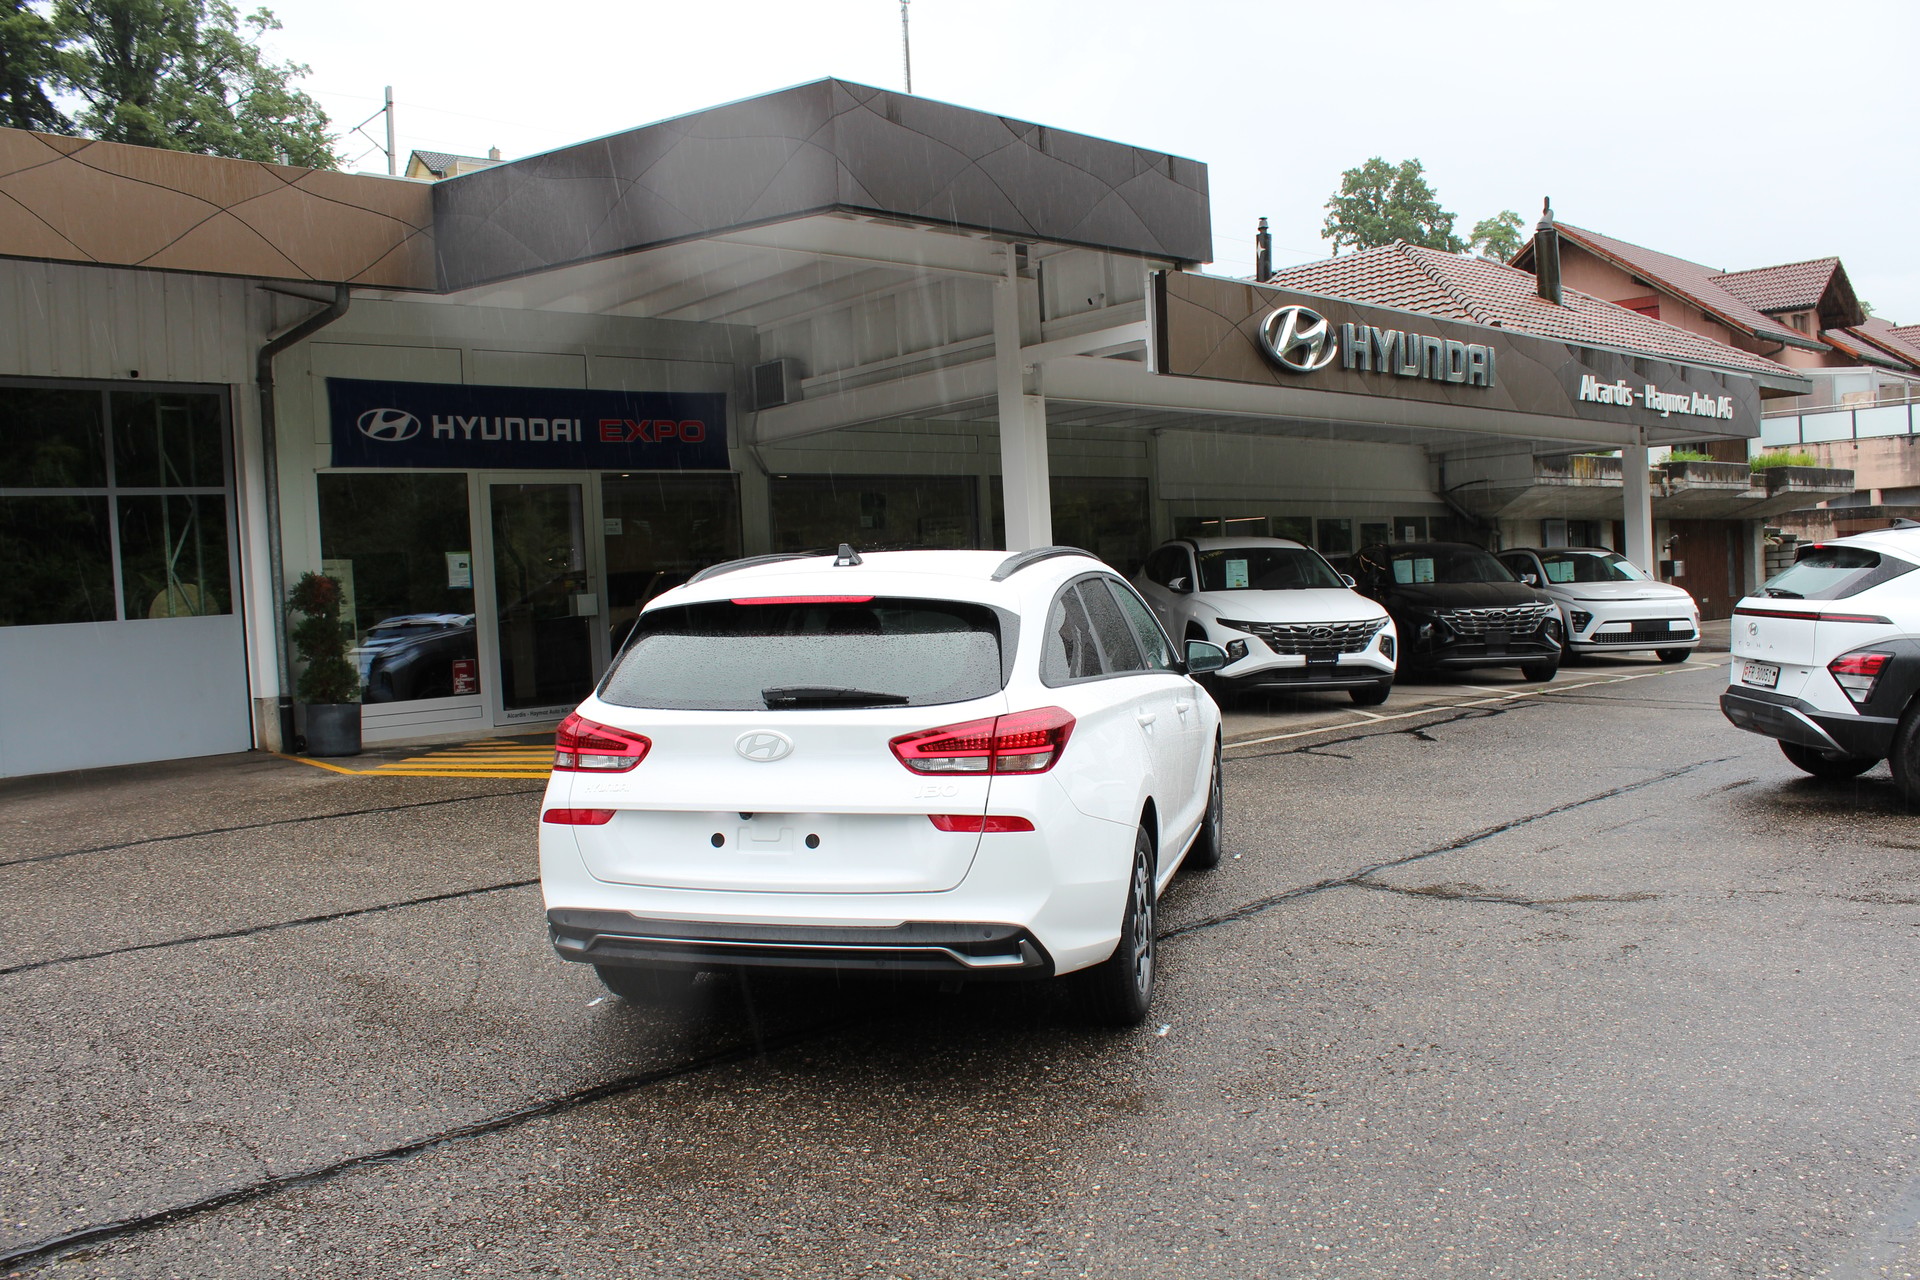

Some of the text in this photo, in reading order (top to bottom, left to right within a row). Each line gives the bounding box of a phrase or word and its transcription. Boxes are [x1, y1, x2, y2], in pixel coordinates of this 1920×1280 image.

[1342, 322, 1495, 388] HYUNDAI
[1579, 374, 1633, 407] Alcardis
[1644, 384, 1691, 418] Haymoz
[1691, 391, 1716, 418] Auto
[1716, 395, 1733, 420] AG
[432, 414, 706, 443] HYUNDAI EXPO
